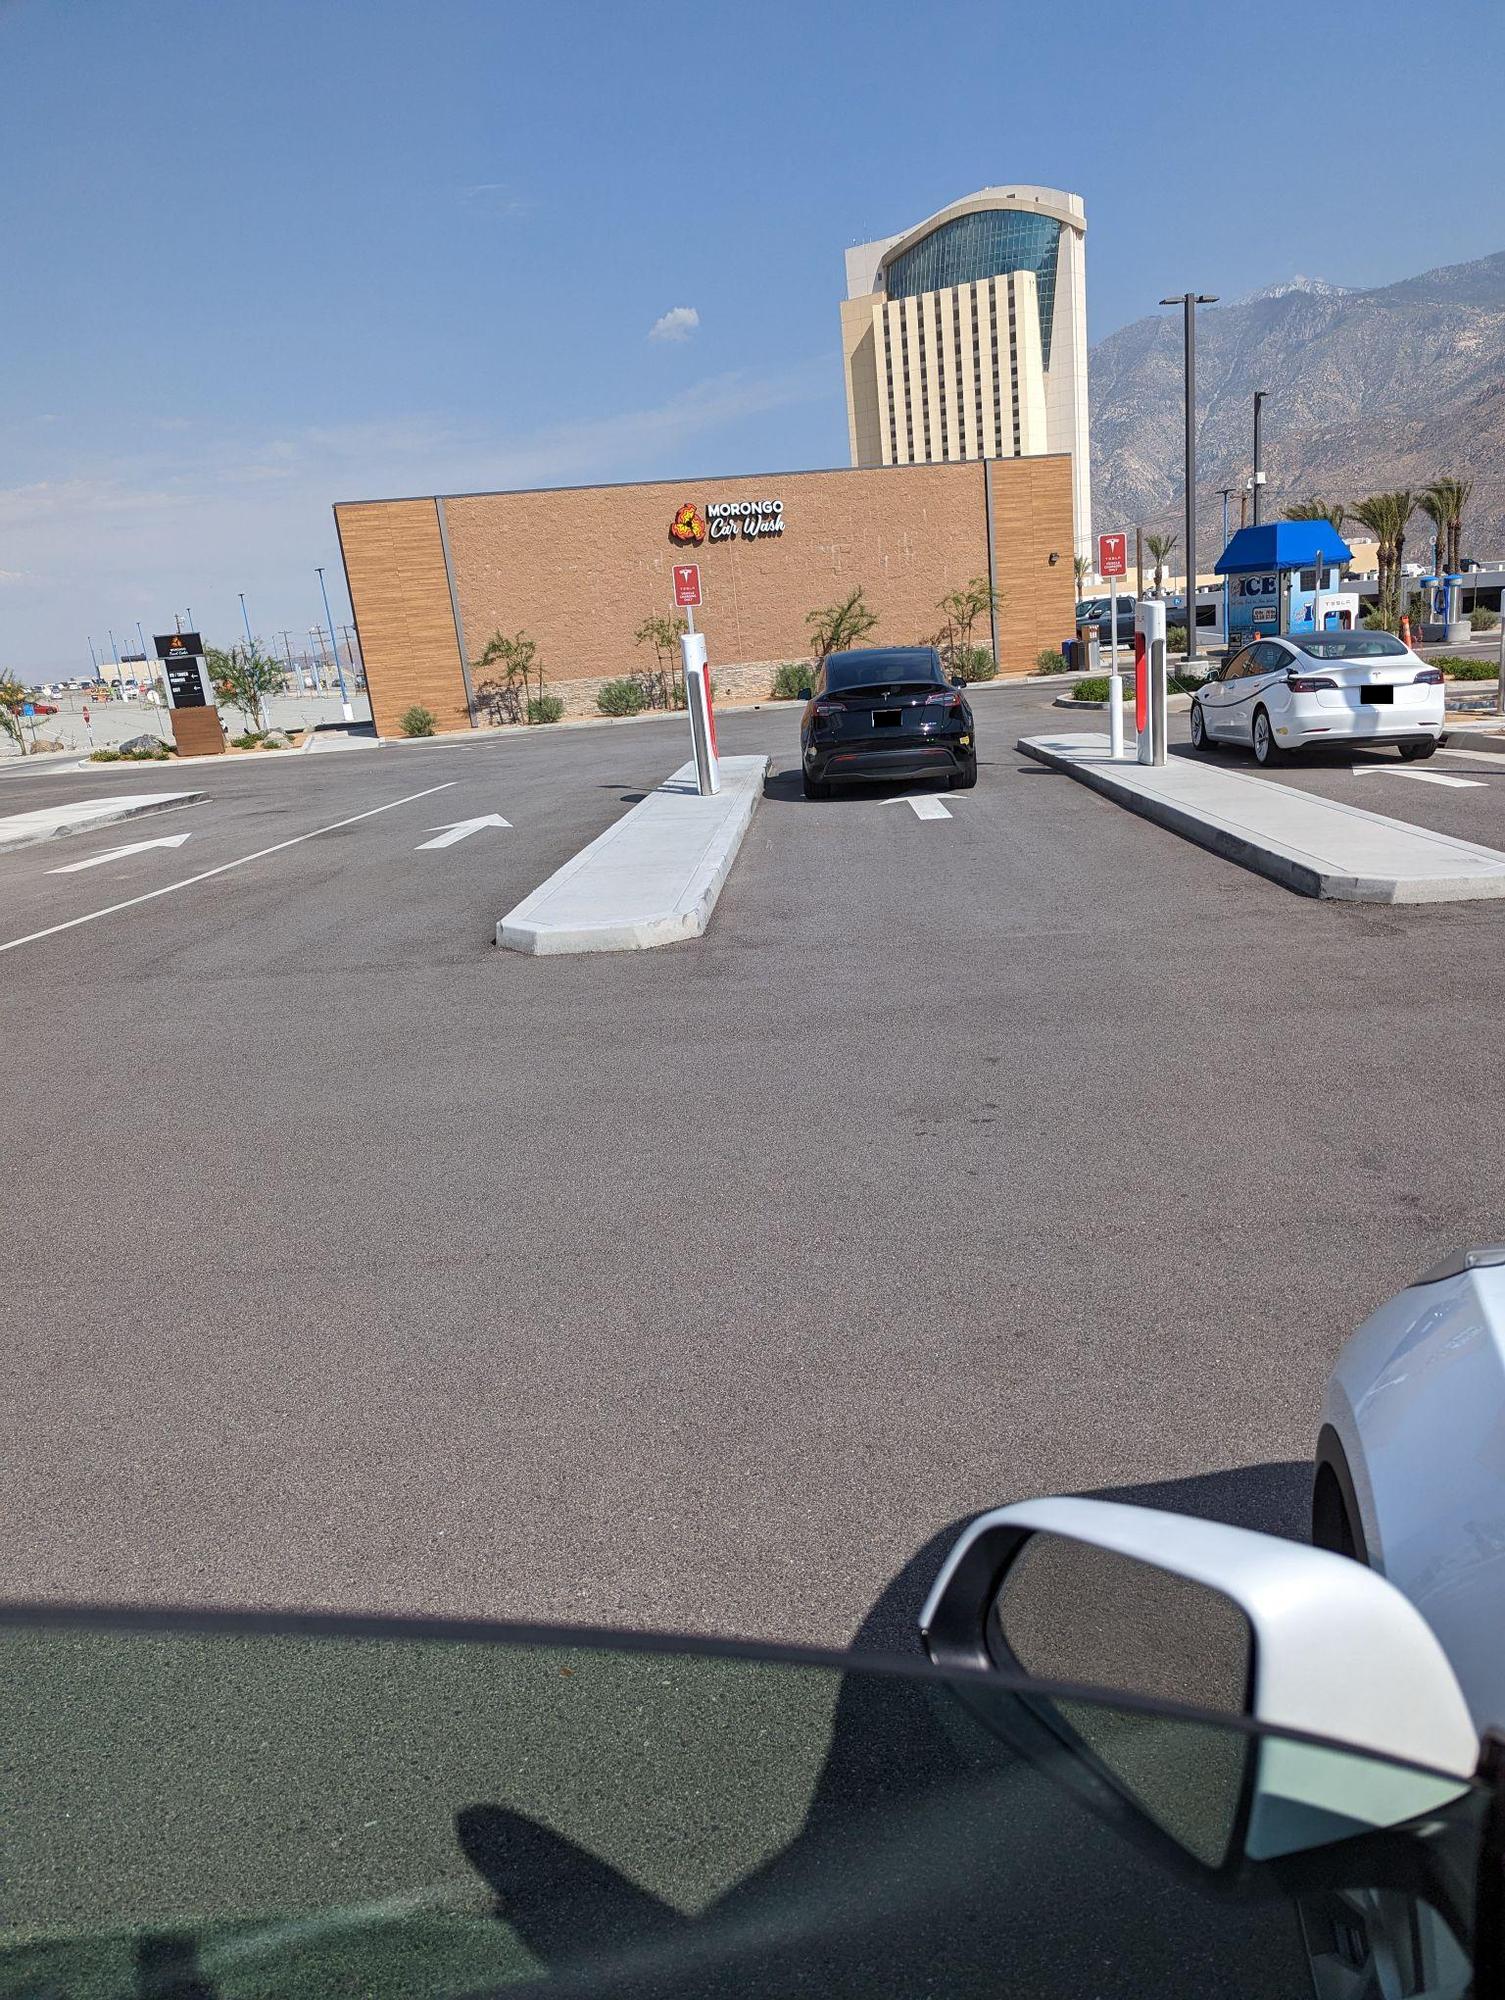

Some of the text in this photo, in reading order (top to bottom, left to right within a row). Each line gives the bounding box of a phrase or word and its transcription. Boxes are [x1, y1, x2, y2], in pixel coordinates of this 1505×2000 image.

[708, 501, 783, 517] MORONGO
[711, 514, 786, 538] Car Wash
[1239, 575, 1277, 596] ICE
